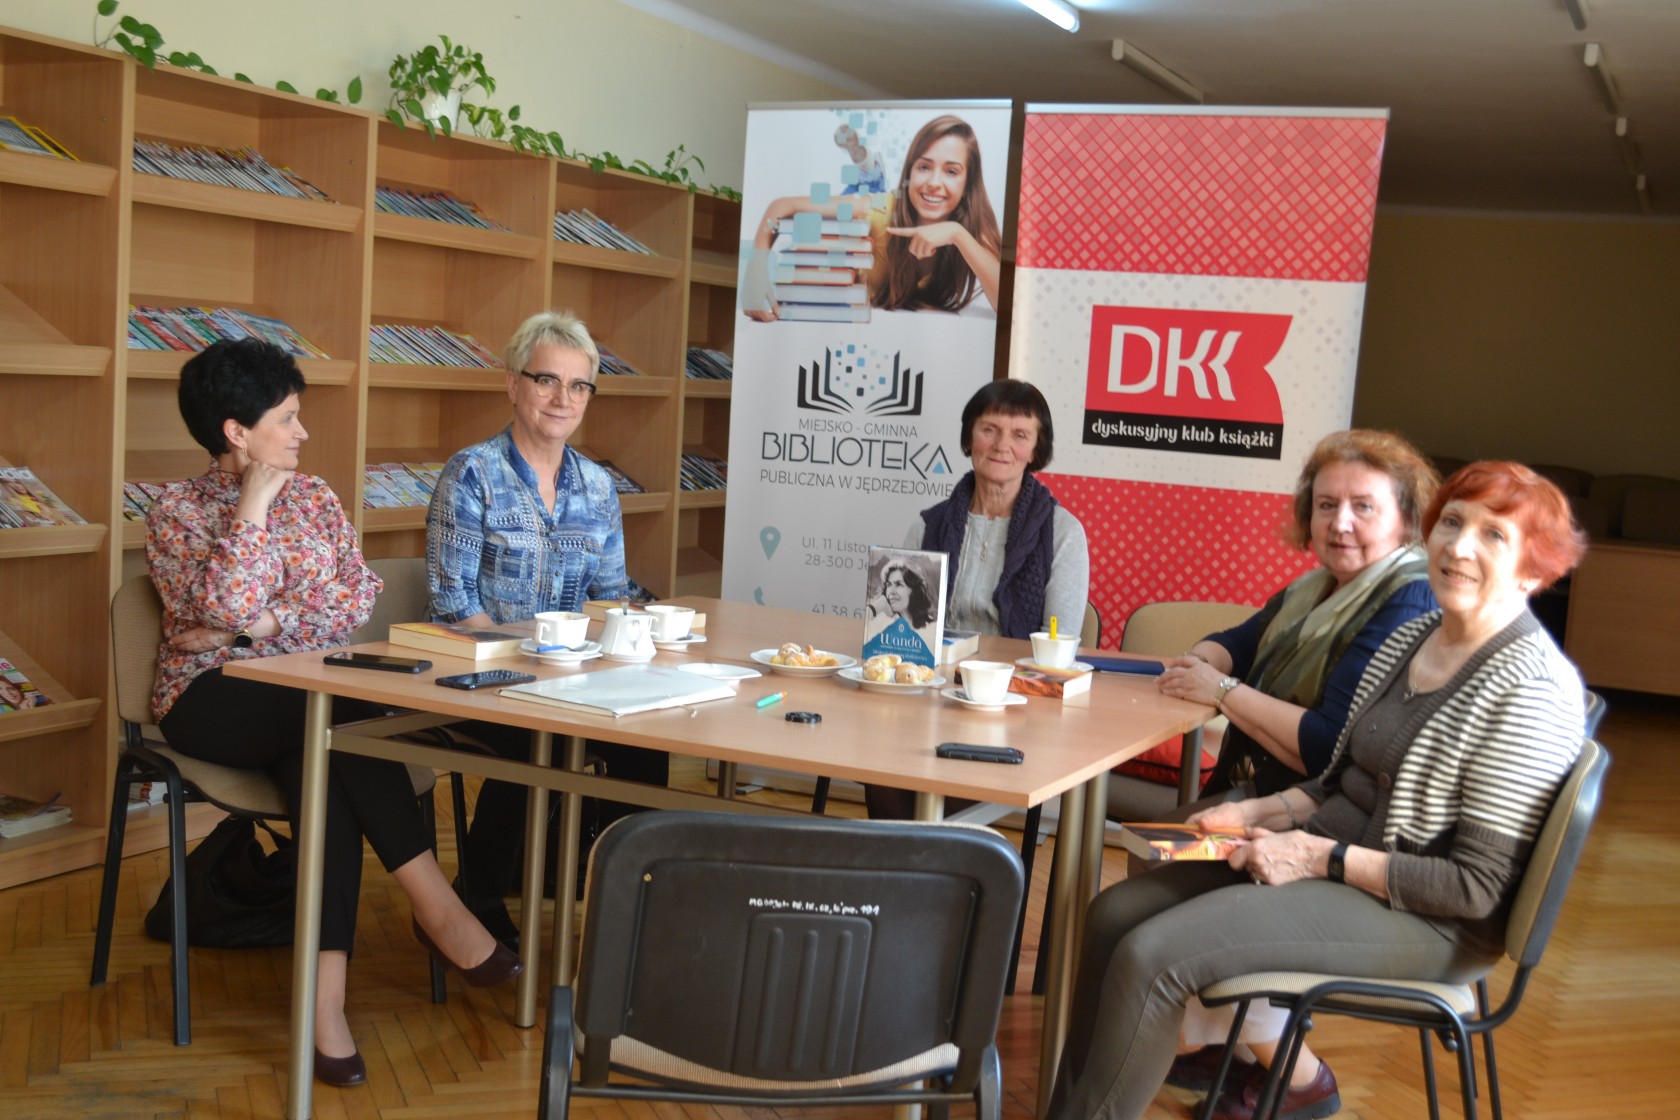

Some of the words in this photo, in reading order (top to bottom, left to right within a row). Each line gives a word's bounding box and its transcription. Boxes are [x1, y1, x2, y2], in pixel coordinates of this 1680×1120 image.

[798, 418, 853, 434] MIEJSKO
[863, 422, 919, 438] GMINNA
[1091, 418, 1178, 444] dyskusyjny
[1181, 424, 1215, 443] klub
[1218, 427, 1275, 450] książki
[761, 431, 954, 480] BIBLIOTEKA
[760, 469, 835, 488] PUBLICZNA
[838, 475, 853, 489] W
[855, 476, 953, 498] JĘDRZEJOWIE
[804, 553, 854, 570] 28-300
[811, 603, 825, 614] 41
[880, 632, 922, 650] Wanda
